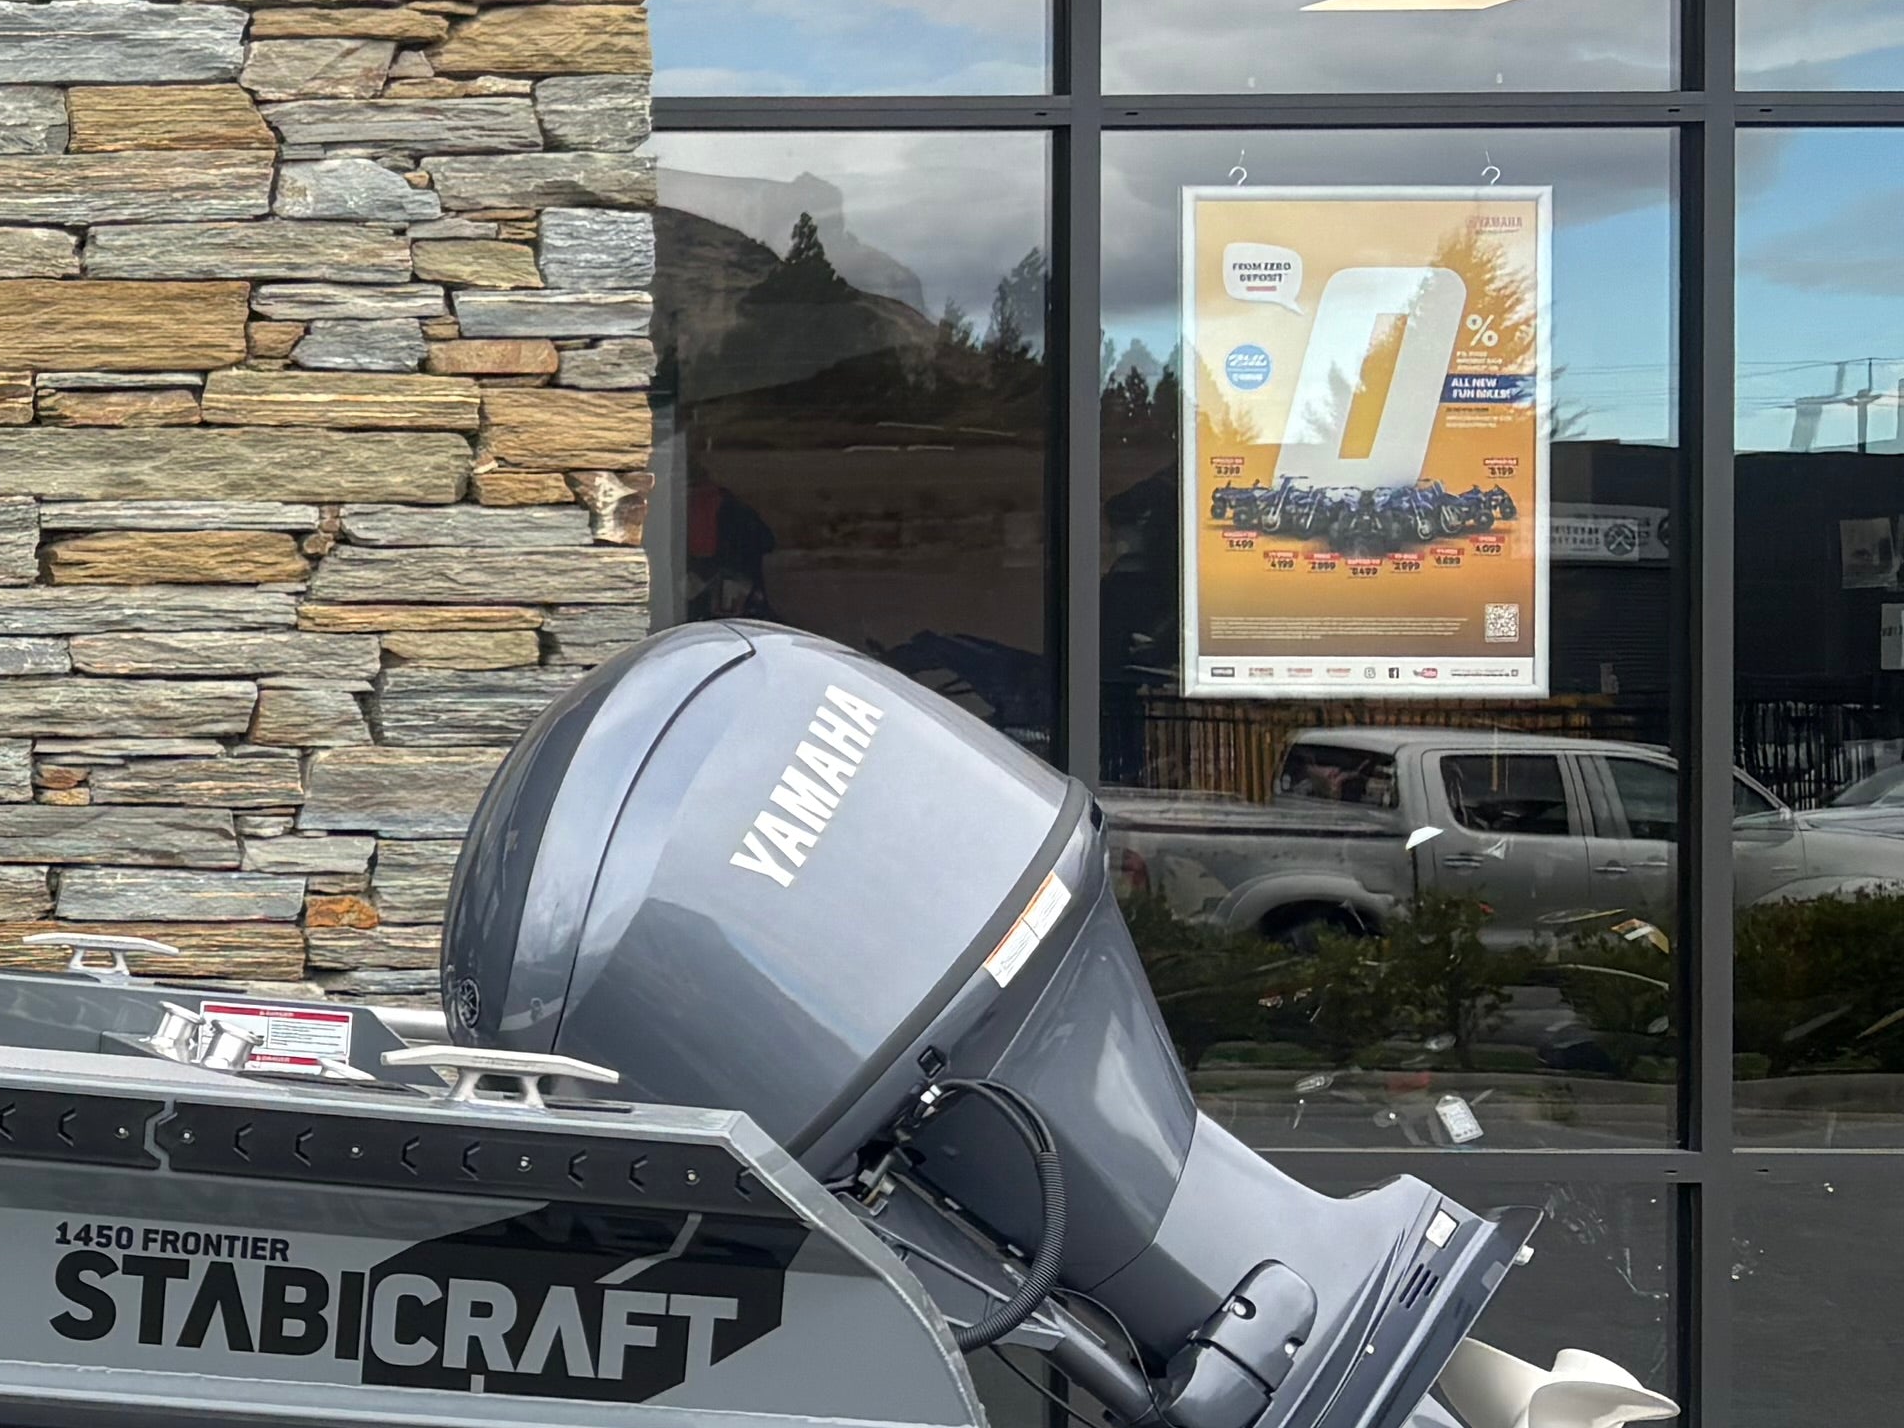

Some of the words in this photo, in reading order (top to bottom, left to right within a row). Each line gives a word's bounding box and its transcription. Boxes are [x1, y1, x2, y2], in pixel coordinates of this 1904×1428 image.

[729, 684, 885, 888] YAMAHA
[54, 1221, 133, 1251] 1450
[142, 1228, 290, 1263] FRONTIER
[48, 1249, 739, 1381] STABICRAFT
